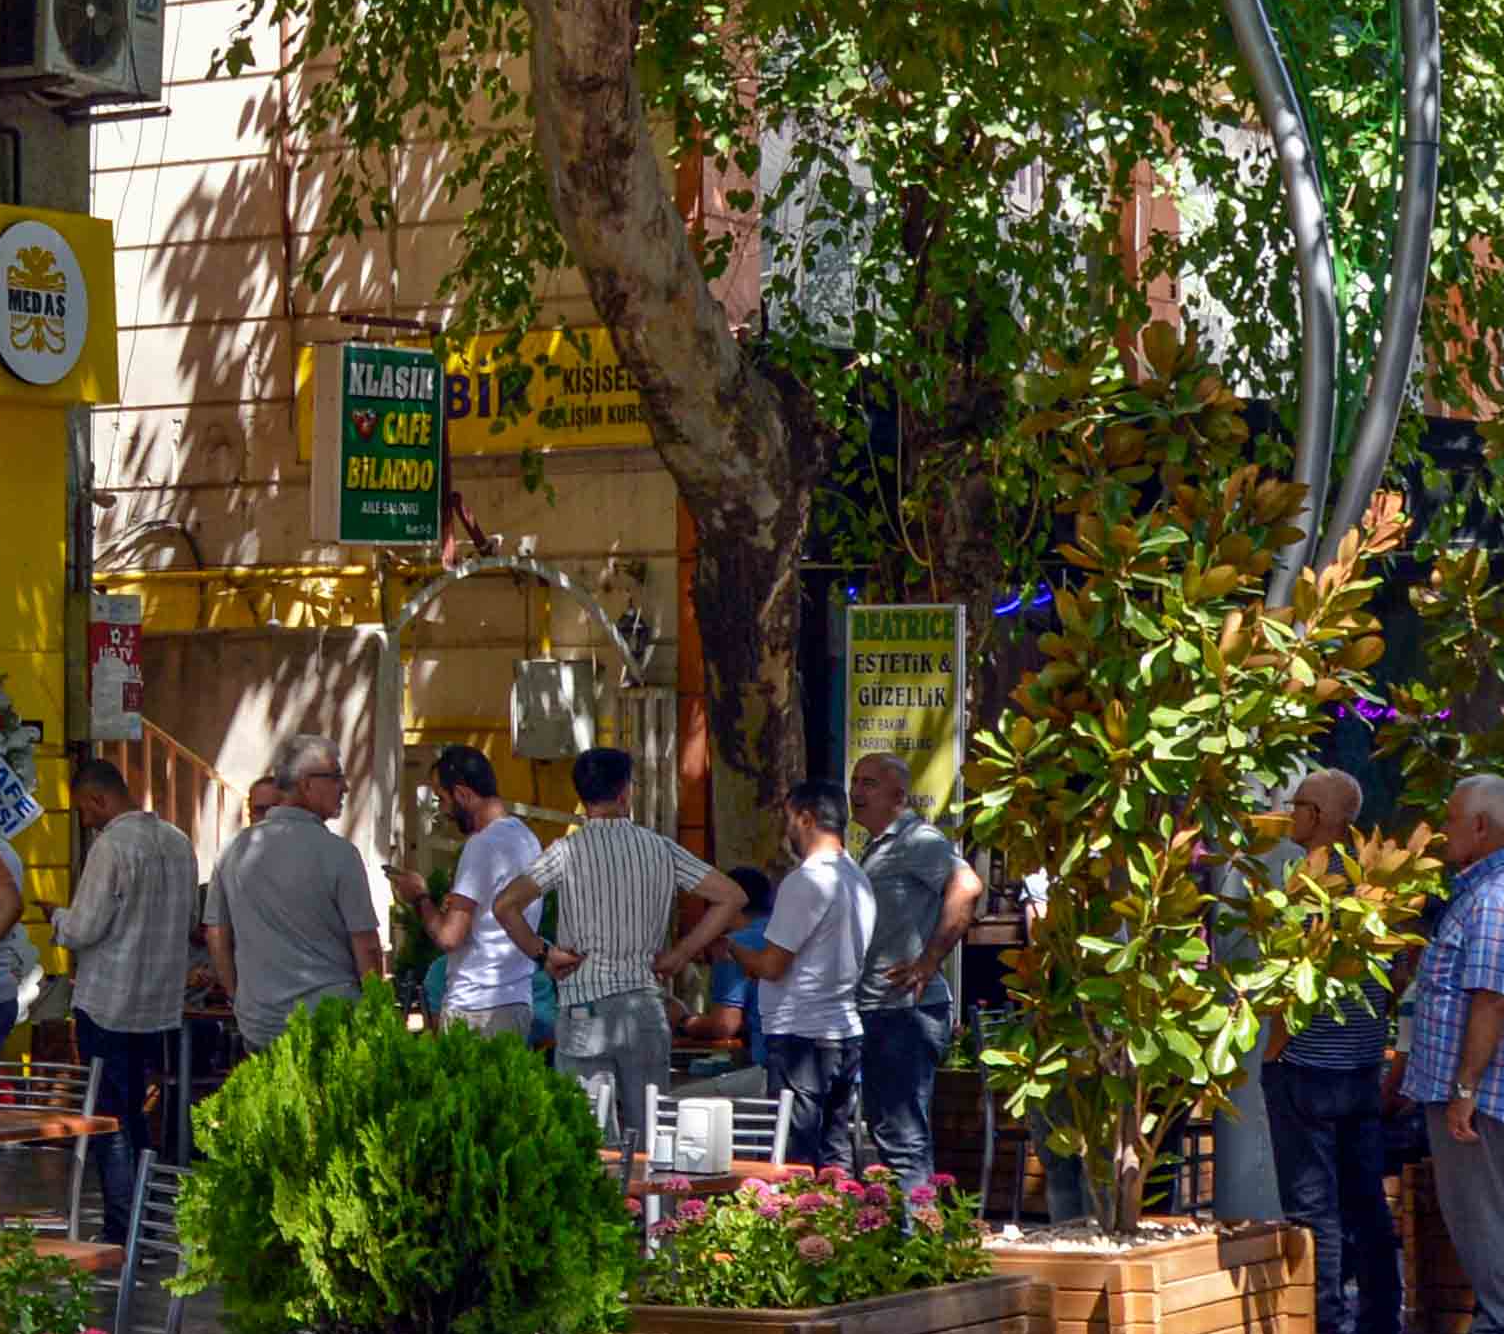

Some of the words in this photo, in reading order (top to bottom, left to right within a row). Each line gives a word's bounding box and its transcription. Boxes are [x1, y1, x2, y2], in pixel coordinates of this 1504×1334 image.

[348, 356, 436, 401] KLASİK
[383, 410, 433, 446] CAFE
[938, 652, 954, 675] &
